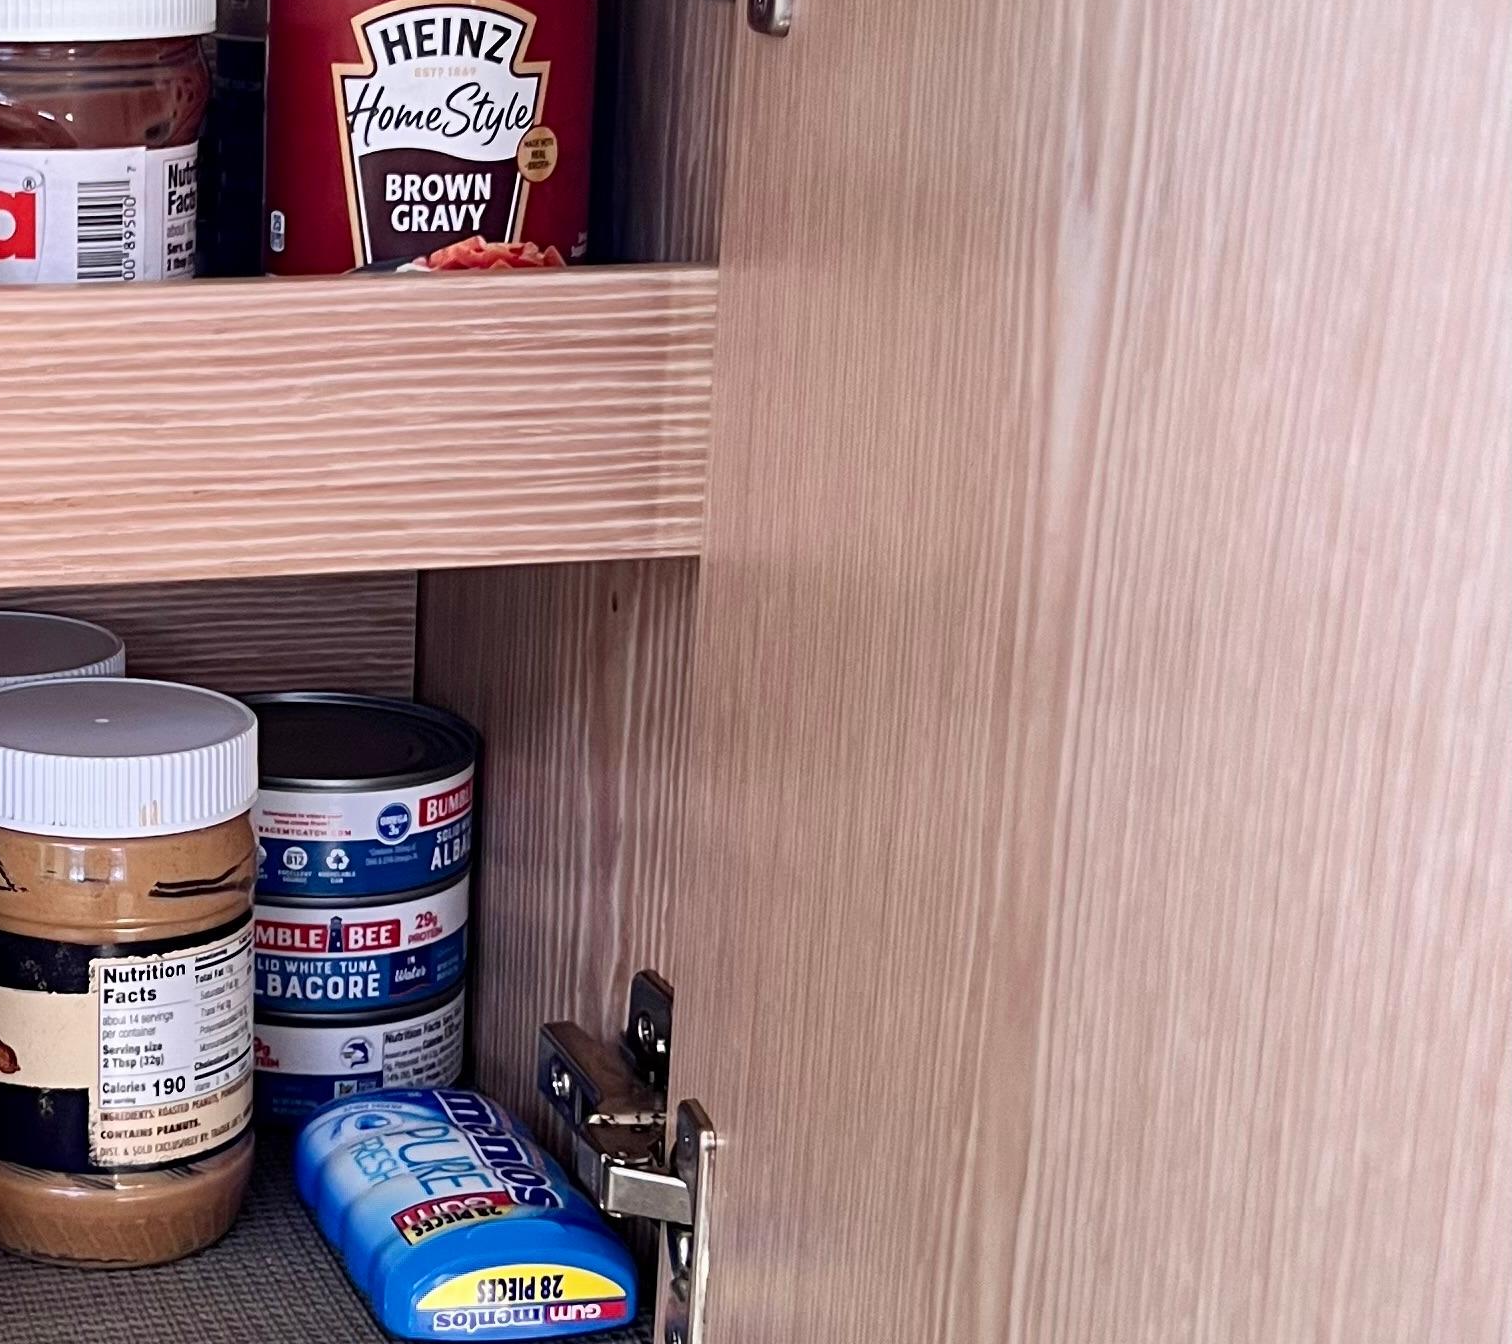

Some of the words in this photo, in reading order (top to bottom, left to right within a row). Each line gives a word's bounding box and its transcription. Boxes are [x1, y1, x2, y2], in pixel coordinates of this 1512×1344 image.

[380, 17, 513, 65] HEINZ
[348, 81, 535, 148] HomeStyle
[386, 173, 492, 202] BROWN
[390, 203, 487, 233] GRAVY
[415, 911, 438, 930] 29g
[348, 925, 394, 950] BEE
[407, 926, 443, 945] PROTEIN
[103, 962, 186, 984] Nutrition
[284, 960, 332, 975] WHITE
[339, 959, 378, 974] TUNA
[394, 966, 426, 983] Water
[195, 972, 213, 985] Total
[103, 987, 157, 1004] Facts
[102, 1012, 127, 1026] about
[129, 1012, 139, 1026] 14
[141, 1010, 174, 1026] servings
[102, 1029, 116, 1040] per
[118, 1026, 156, 1039] container
[103, 1043, 141, 1056] Serving
[144, 1041, 163, 1053] size
[102, 1058, 109, 1068] 2
[112, 1055, 137, 1069] Tbsp
[140, 1053, 164, 1068] (32g)
[102, 1078, 146, 1094] Calories
[152, 1075, 186, 1097] 190
[100, 1111, 155, 1122] INGREDIENTS:
[158, 1103, 189, 1117] ROASTED
[100, 1128, 153, 1140] CONTAINS
[156, 1118, 202, 1135] PEANUTS.
[132, 1145, 153, 1155] SOLD
[155, 1137, 198, 1152] EXCLUSIVELY
[433, 1090, 564, 1209] mentos
[386, 1125, 494, 1196] PURE
[411, 1207, 479, 1237] PIECES
[477, 1276, 536, 1304] PIECES
[540, 1274, 564, 1299] 28
[434, 1306, 544, 1333] mentos
